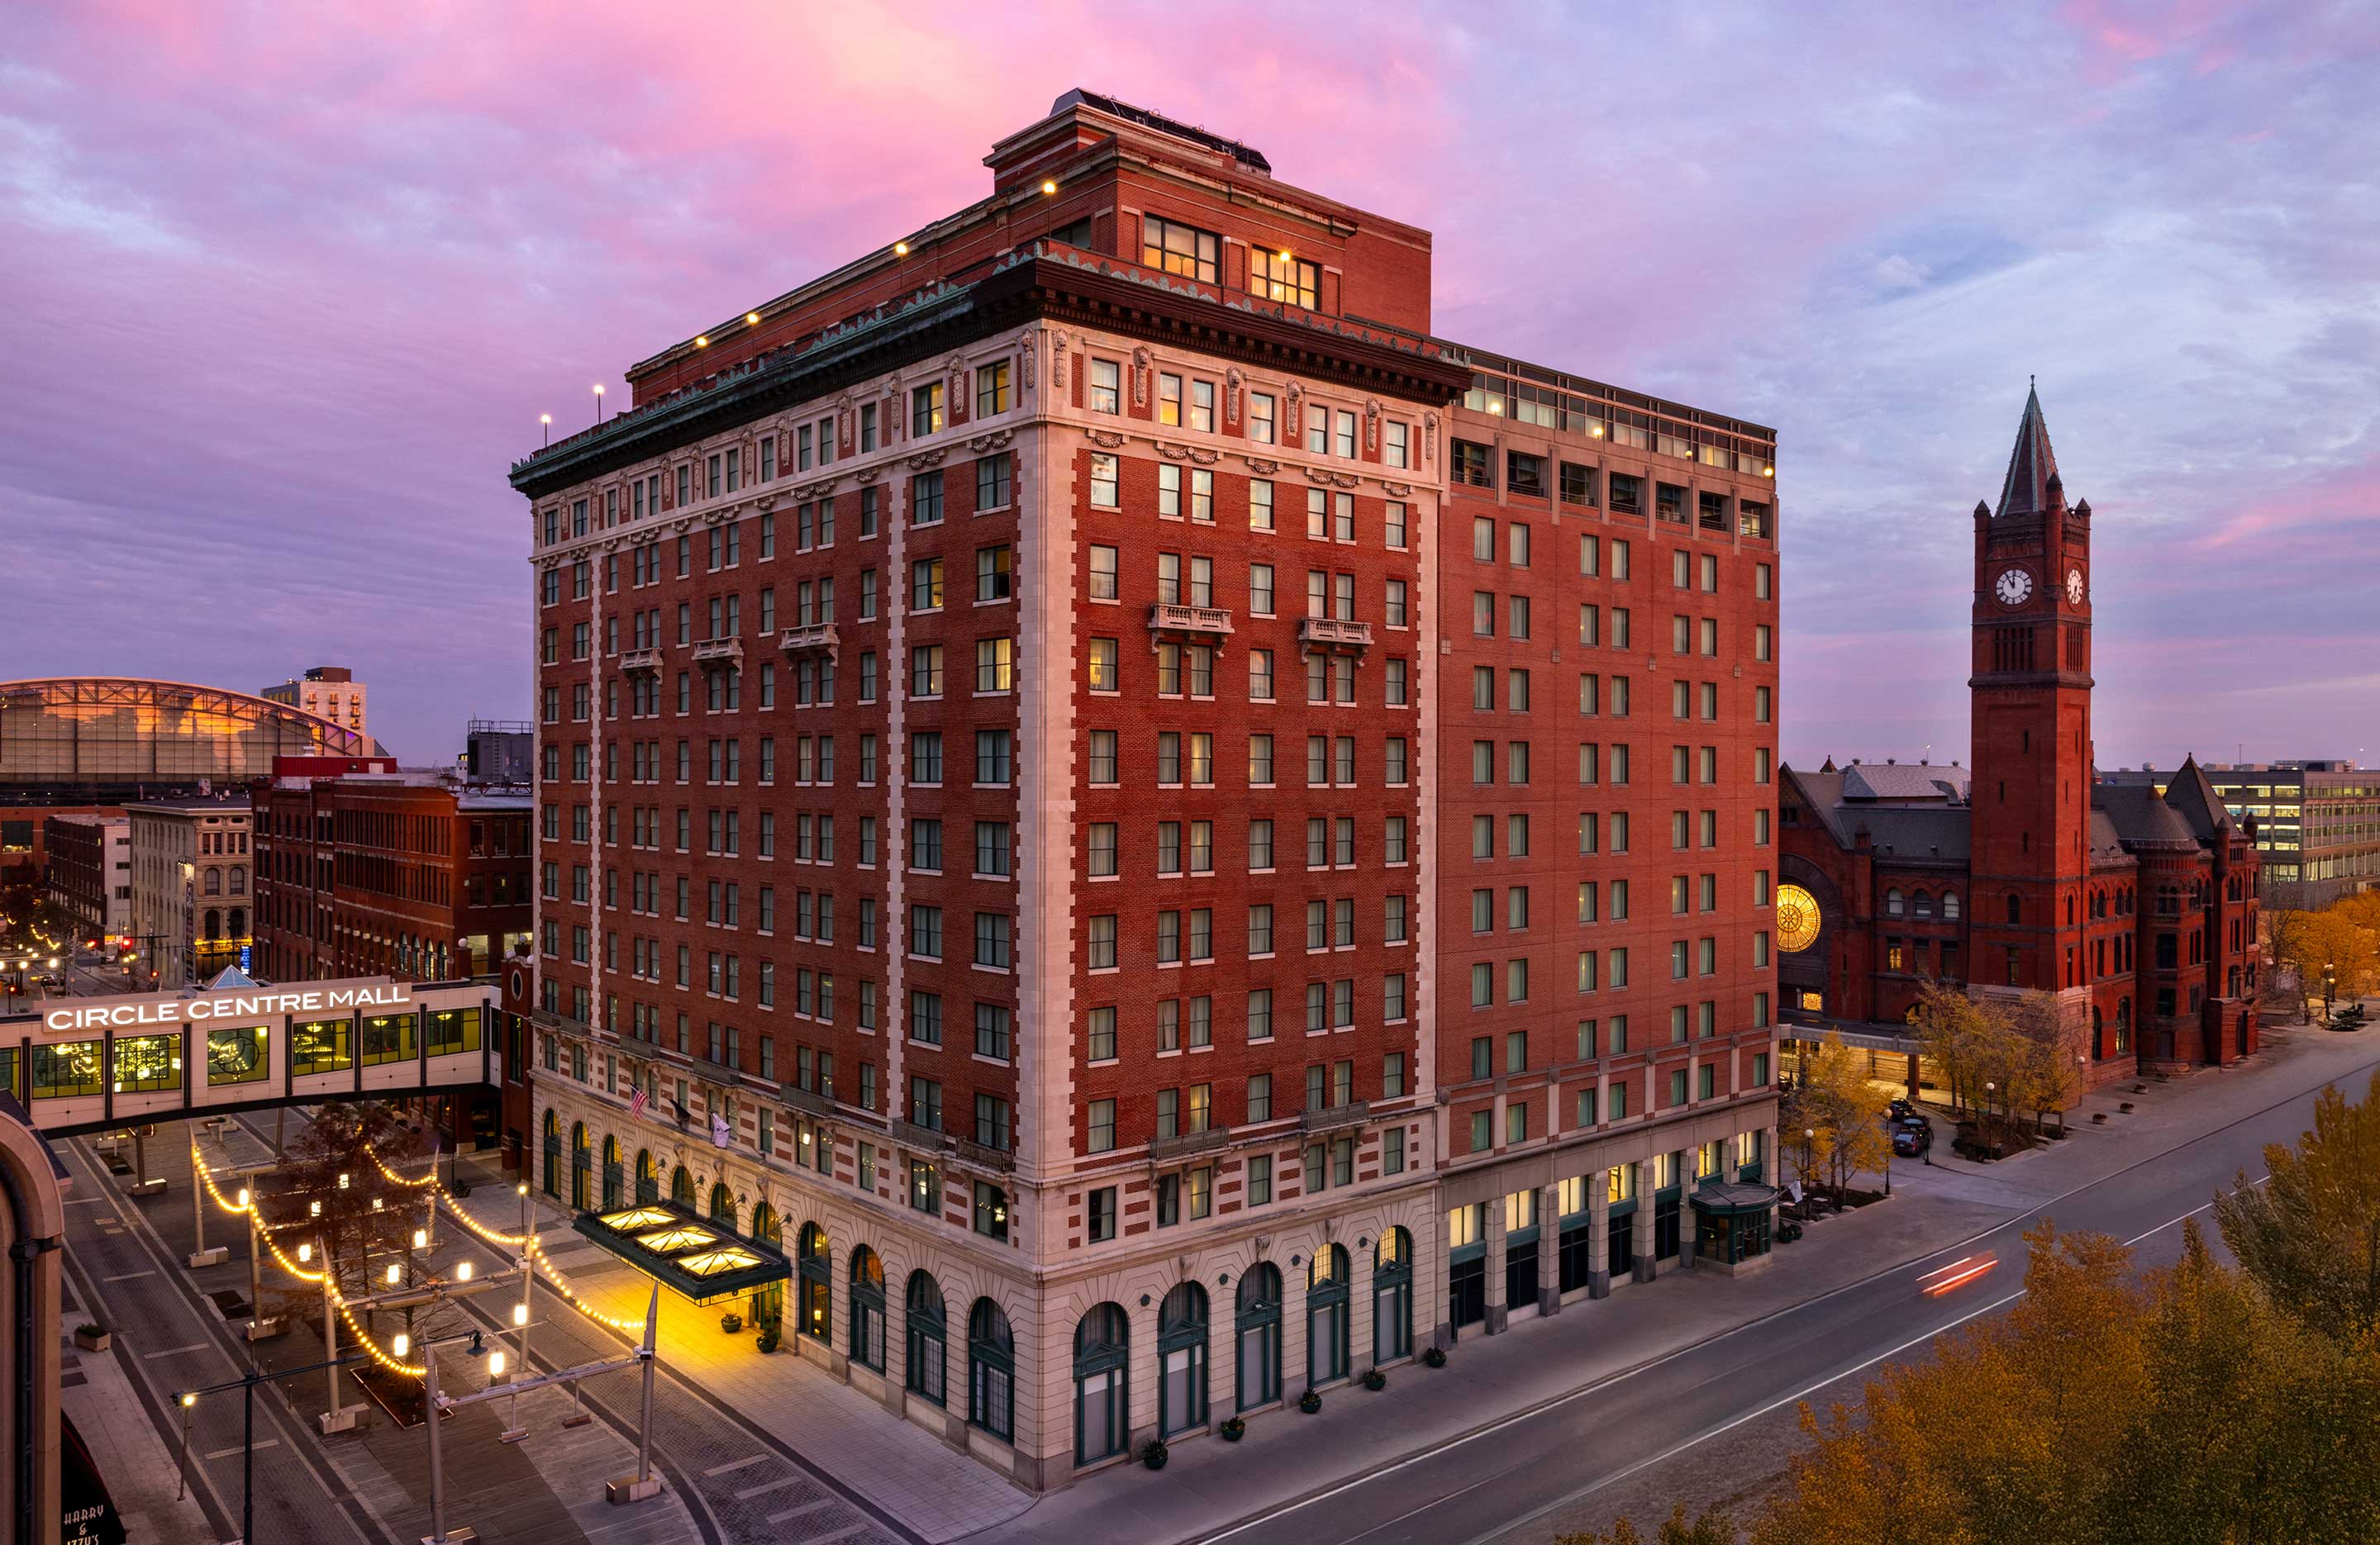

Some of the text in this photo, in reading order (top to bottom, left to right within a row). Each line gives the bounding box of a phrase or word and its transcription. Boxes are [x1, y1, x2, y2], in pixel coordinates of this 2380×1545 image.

[47, 986, 410, 1029] CIRCLE CENTRE MALL
[64, 1505, 104, 1525] HARRY
[79, 1523, 88, 1536] &
